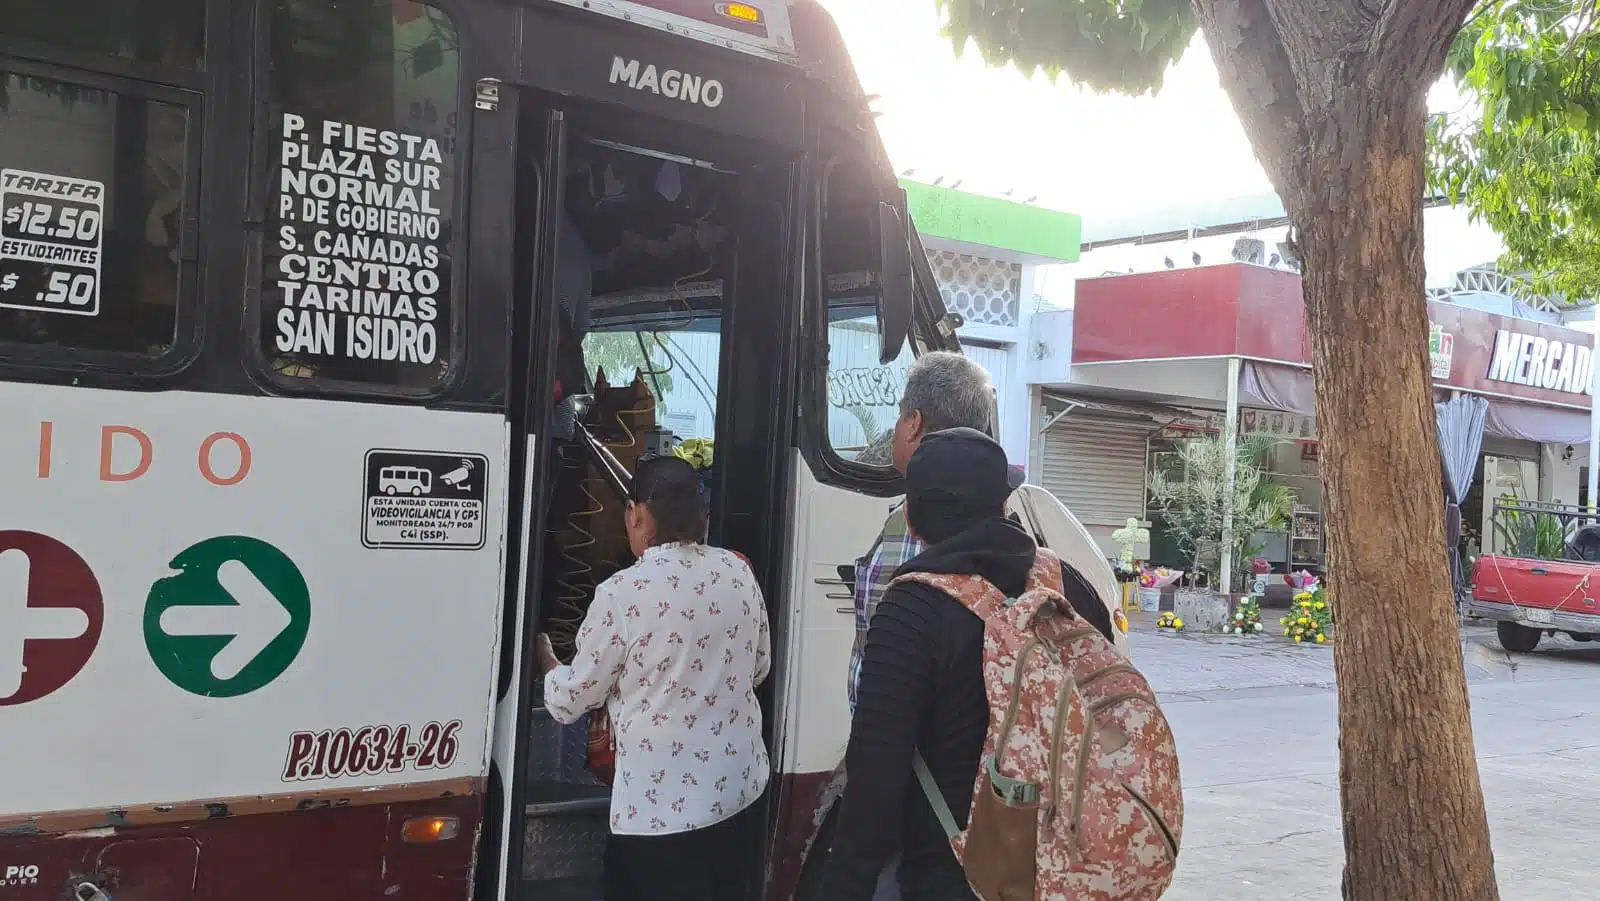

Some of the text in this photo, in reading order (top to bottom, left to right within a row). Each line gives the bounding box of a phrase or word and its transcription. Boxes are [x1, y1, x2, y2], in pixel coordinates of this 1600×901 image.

[609, 56, 724, 108] MAGNO
[283, 113, 308, 141] P.
[323, 119, 443, 164] FIESTA
[3, 174, 101, 199] TARIFA
[281, 141, 441, 191] PLAZA SUR
[280, 167, 441, 216] NORMAL
[4, 201, 100, 241] $12.50
[279, 194, 440, 240] P. DE GOBIERNO
[0, 241, 98, 264] ESTUDIANTES
[279, 225, 439, 269] S. CAÑADAS
[277, 280, 438, 321] TARIMAS
[276, 307, 437, 365] SAN ISIDRO
[371, 506, 480, 521] VIDEOVIGILANCIA Y GPS
[373, 498, 394, 506] ESTA
[396, 499, 427, 507] UNIDAD
[428, 500, 460, 508] CUENTA
[376, 519, 473, 529] MONITOREADA 24/7 POR
[420, 530, 449, 541] (SSP).
[282, 720, 461, 781] P.10634-26
